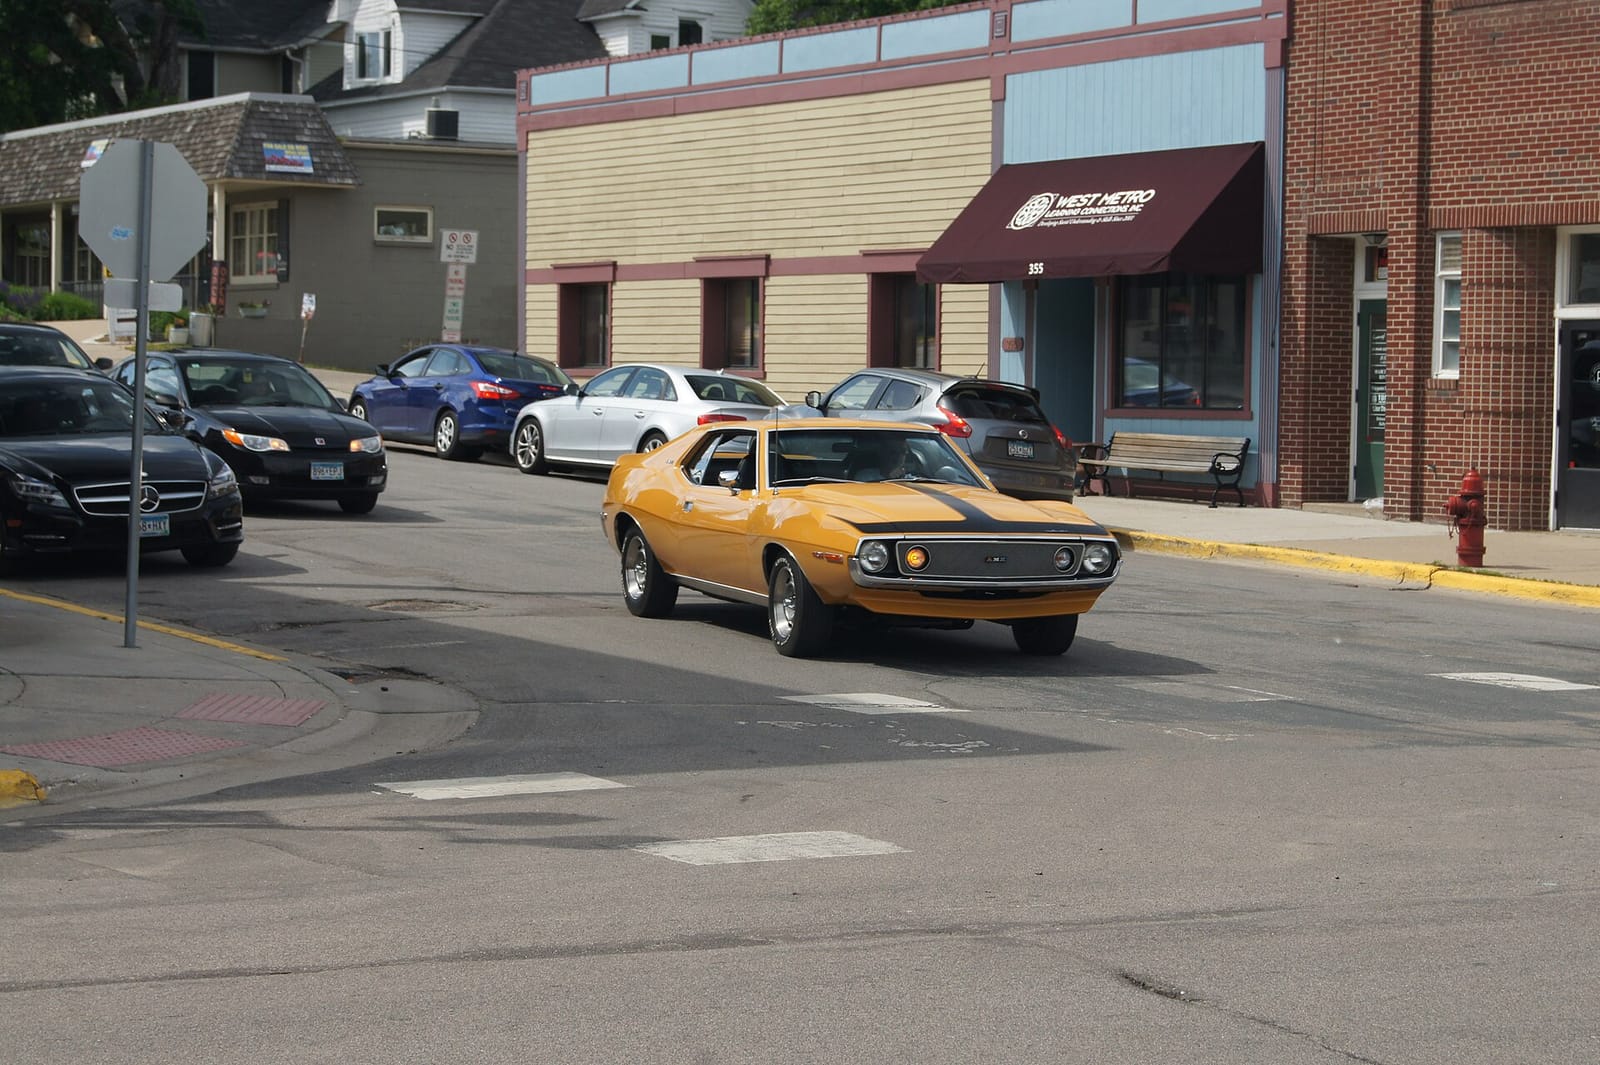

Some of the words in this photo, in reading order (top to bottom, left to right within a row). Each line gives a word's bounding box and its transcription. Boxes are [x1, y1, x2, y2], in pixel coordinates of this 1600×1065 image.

[1056, 193, 1101, 208] WEST
[1098, 189, 1156, 205] METRO
[1045, 209, 1081, 218] LEARNING
[1080, 204, 1129, 216] CONNECTIONS
[1028, 262, 1044, 275] 355
